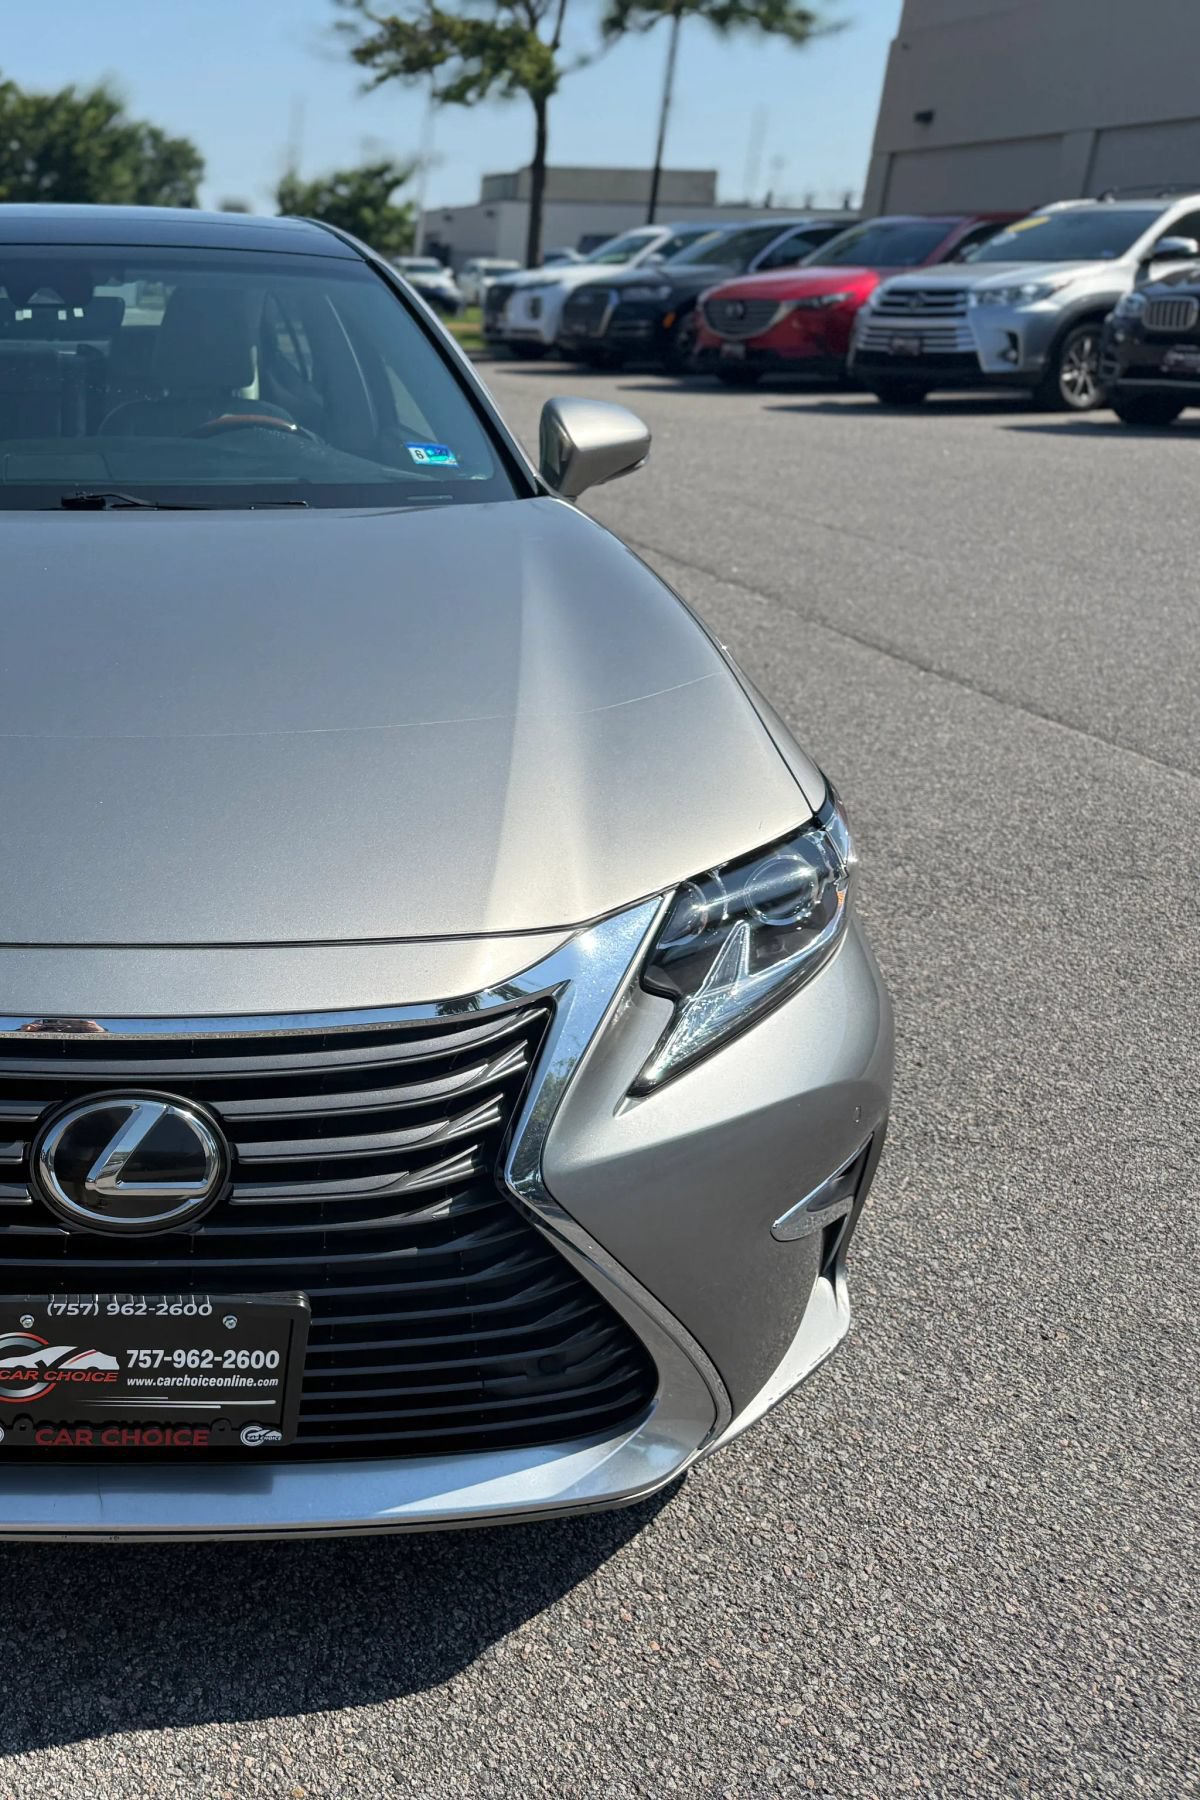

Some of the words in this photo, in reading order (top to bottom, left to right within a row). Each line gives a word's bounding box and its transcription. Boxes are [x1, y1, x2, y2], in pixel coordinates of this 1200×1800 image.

[46, 1302, 100, 1317] (757)
[106, 1303, 213, 1316] 962-2600
[126, 1349, 280, 1369] 757-962-2600
[43, 1371, 120, 1382] CHOICE
[126, 1374, 279, 1388] www.carchoiceonline.com
[35, 1428, 92, 1447] CAR
[100, 1428, 209, 1447] CHOICE
